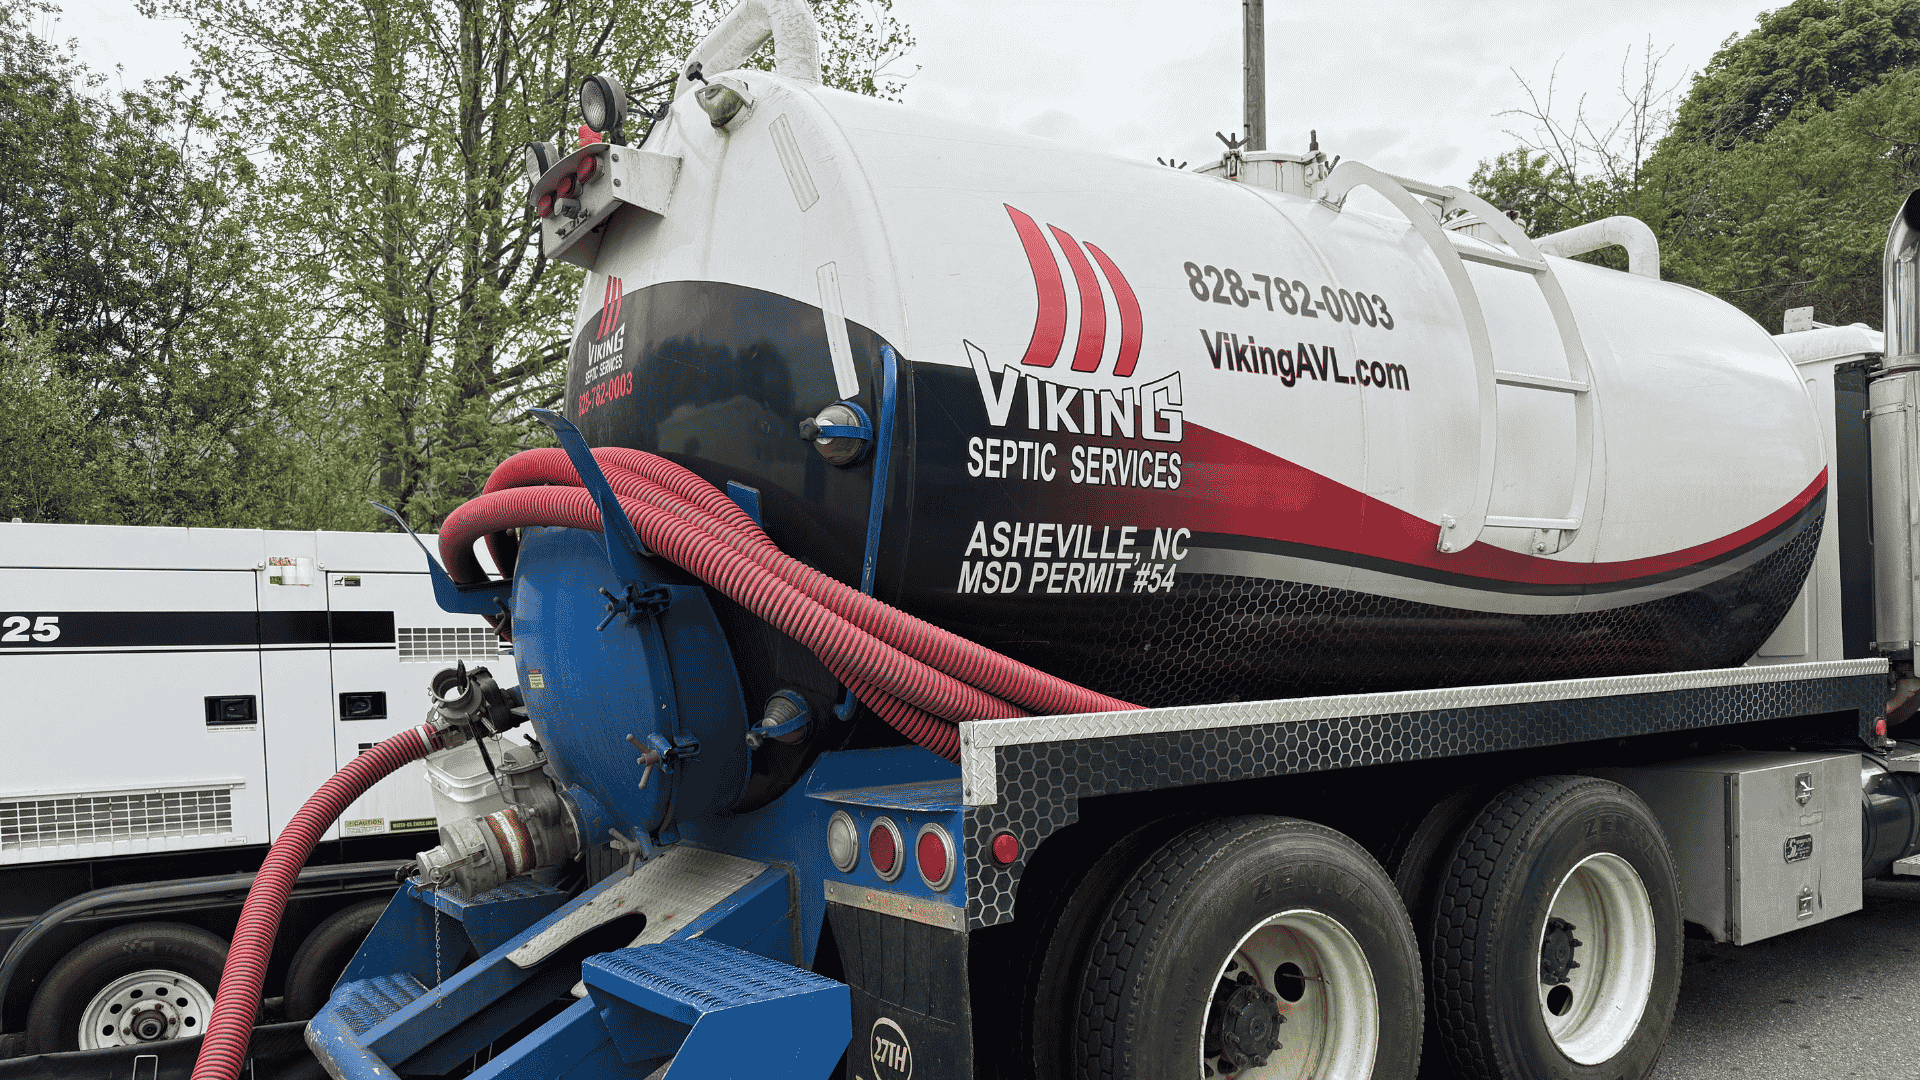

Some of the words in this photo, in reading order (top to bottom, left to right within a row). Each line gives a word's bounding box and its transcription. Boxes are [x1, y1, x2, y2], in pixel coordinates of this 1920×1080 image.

[1184, 261, 1394, 330] 828-782-0003
[589, 322, 625, 367] VIKING
[1199, 329, 1410, 391] VikingAVL.com
[585, 365, 598, 385] SEPTIC
[599, 354, 622, 377] SERVICES
[963, 339, 1183, 442] VIKING
[579, 371, 633, 417] 828-782-0003
[967, 436, 1057, 482] SEPTIC
[1070, 445, 1182, 489] SERVICES
[964, 520, 1141, 565] ASHEVILLE,
[1150, 526, 1191, 561] NC
[957, 560, 1022, 594] MSD
[1028, 562, 1131, 593] PERMIT
[1132, 562, 1177, 593] #54
[1, 616, 60, 642] 25
[874, 1036, 907, 1073] 27TH
